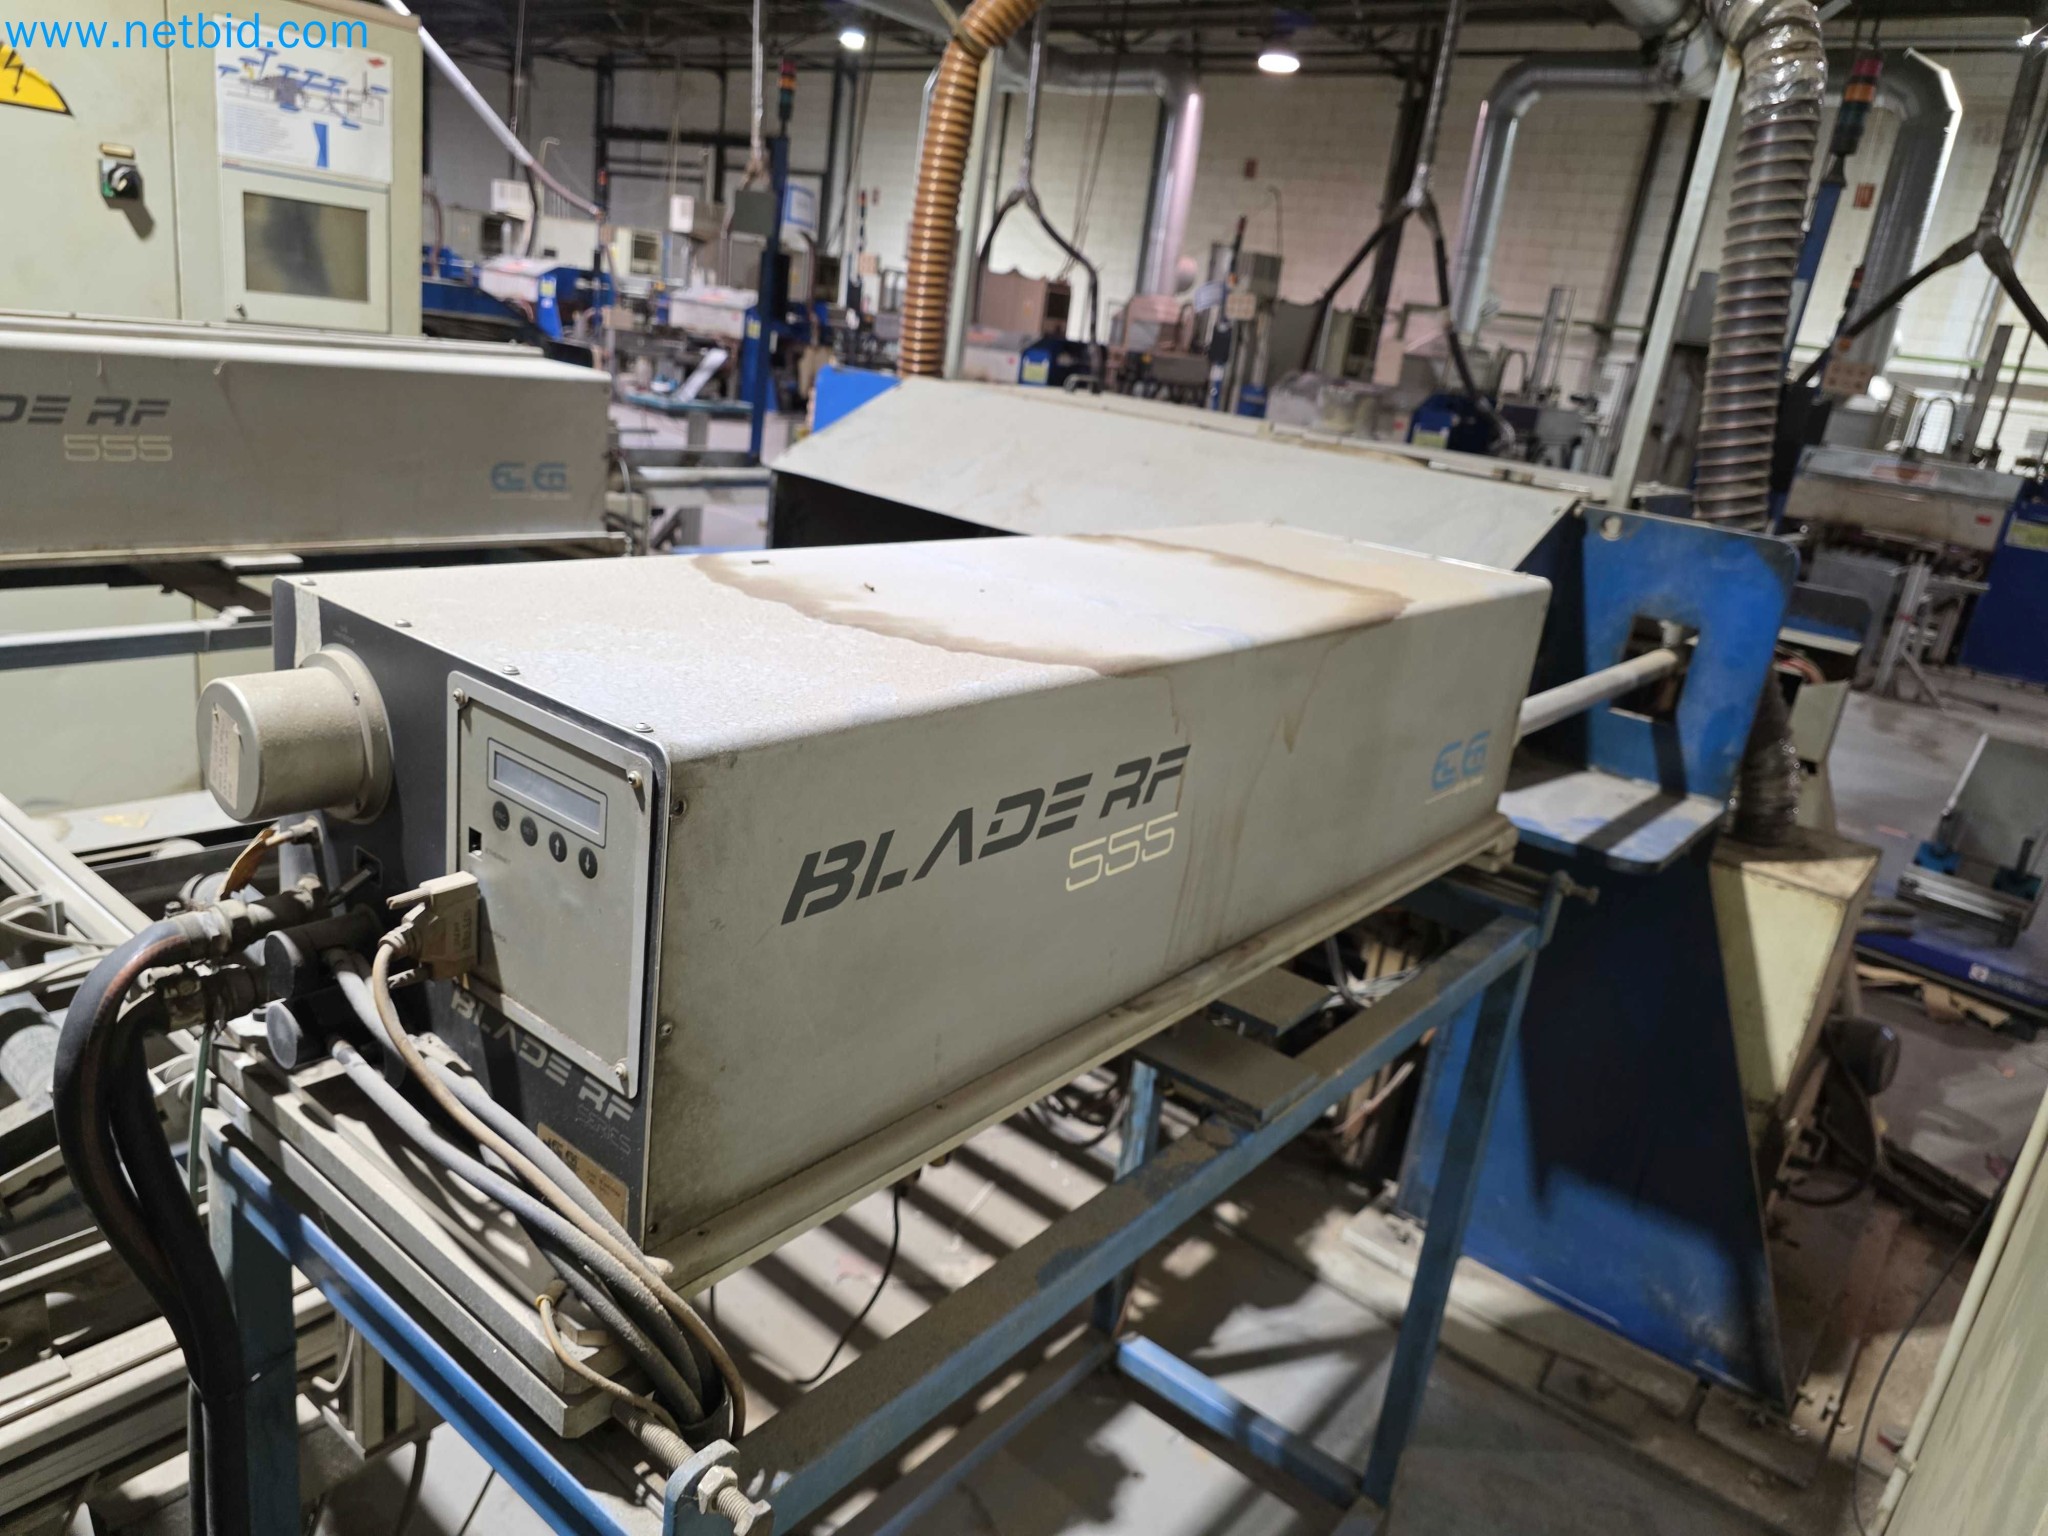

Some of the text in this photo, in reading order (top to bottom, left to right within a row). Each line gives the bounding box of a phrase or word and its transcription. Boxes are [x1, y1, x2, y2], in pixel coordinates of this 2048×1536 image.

[86, 398, 171, 427] RF
[781, 744, 1191, 925] BLADE RF
[451, 989, 634, 1121] BLADE RF
